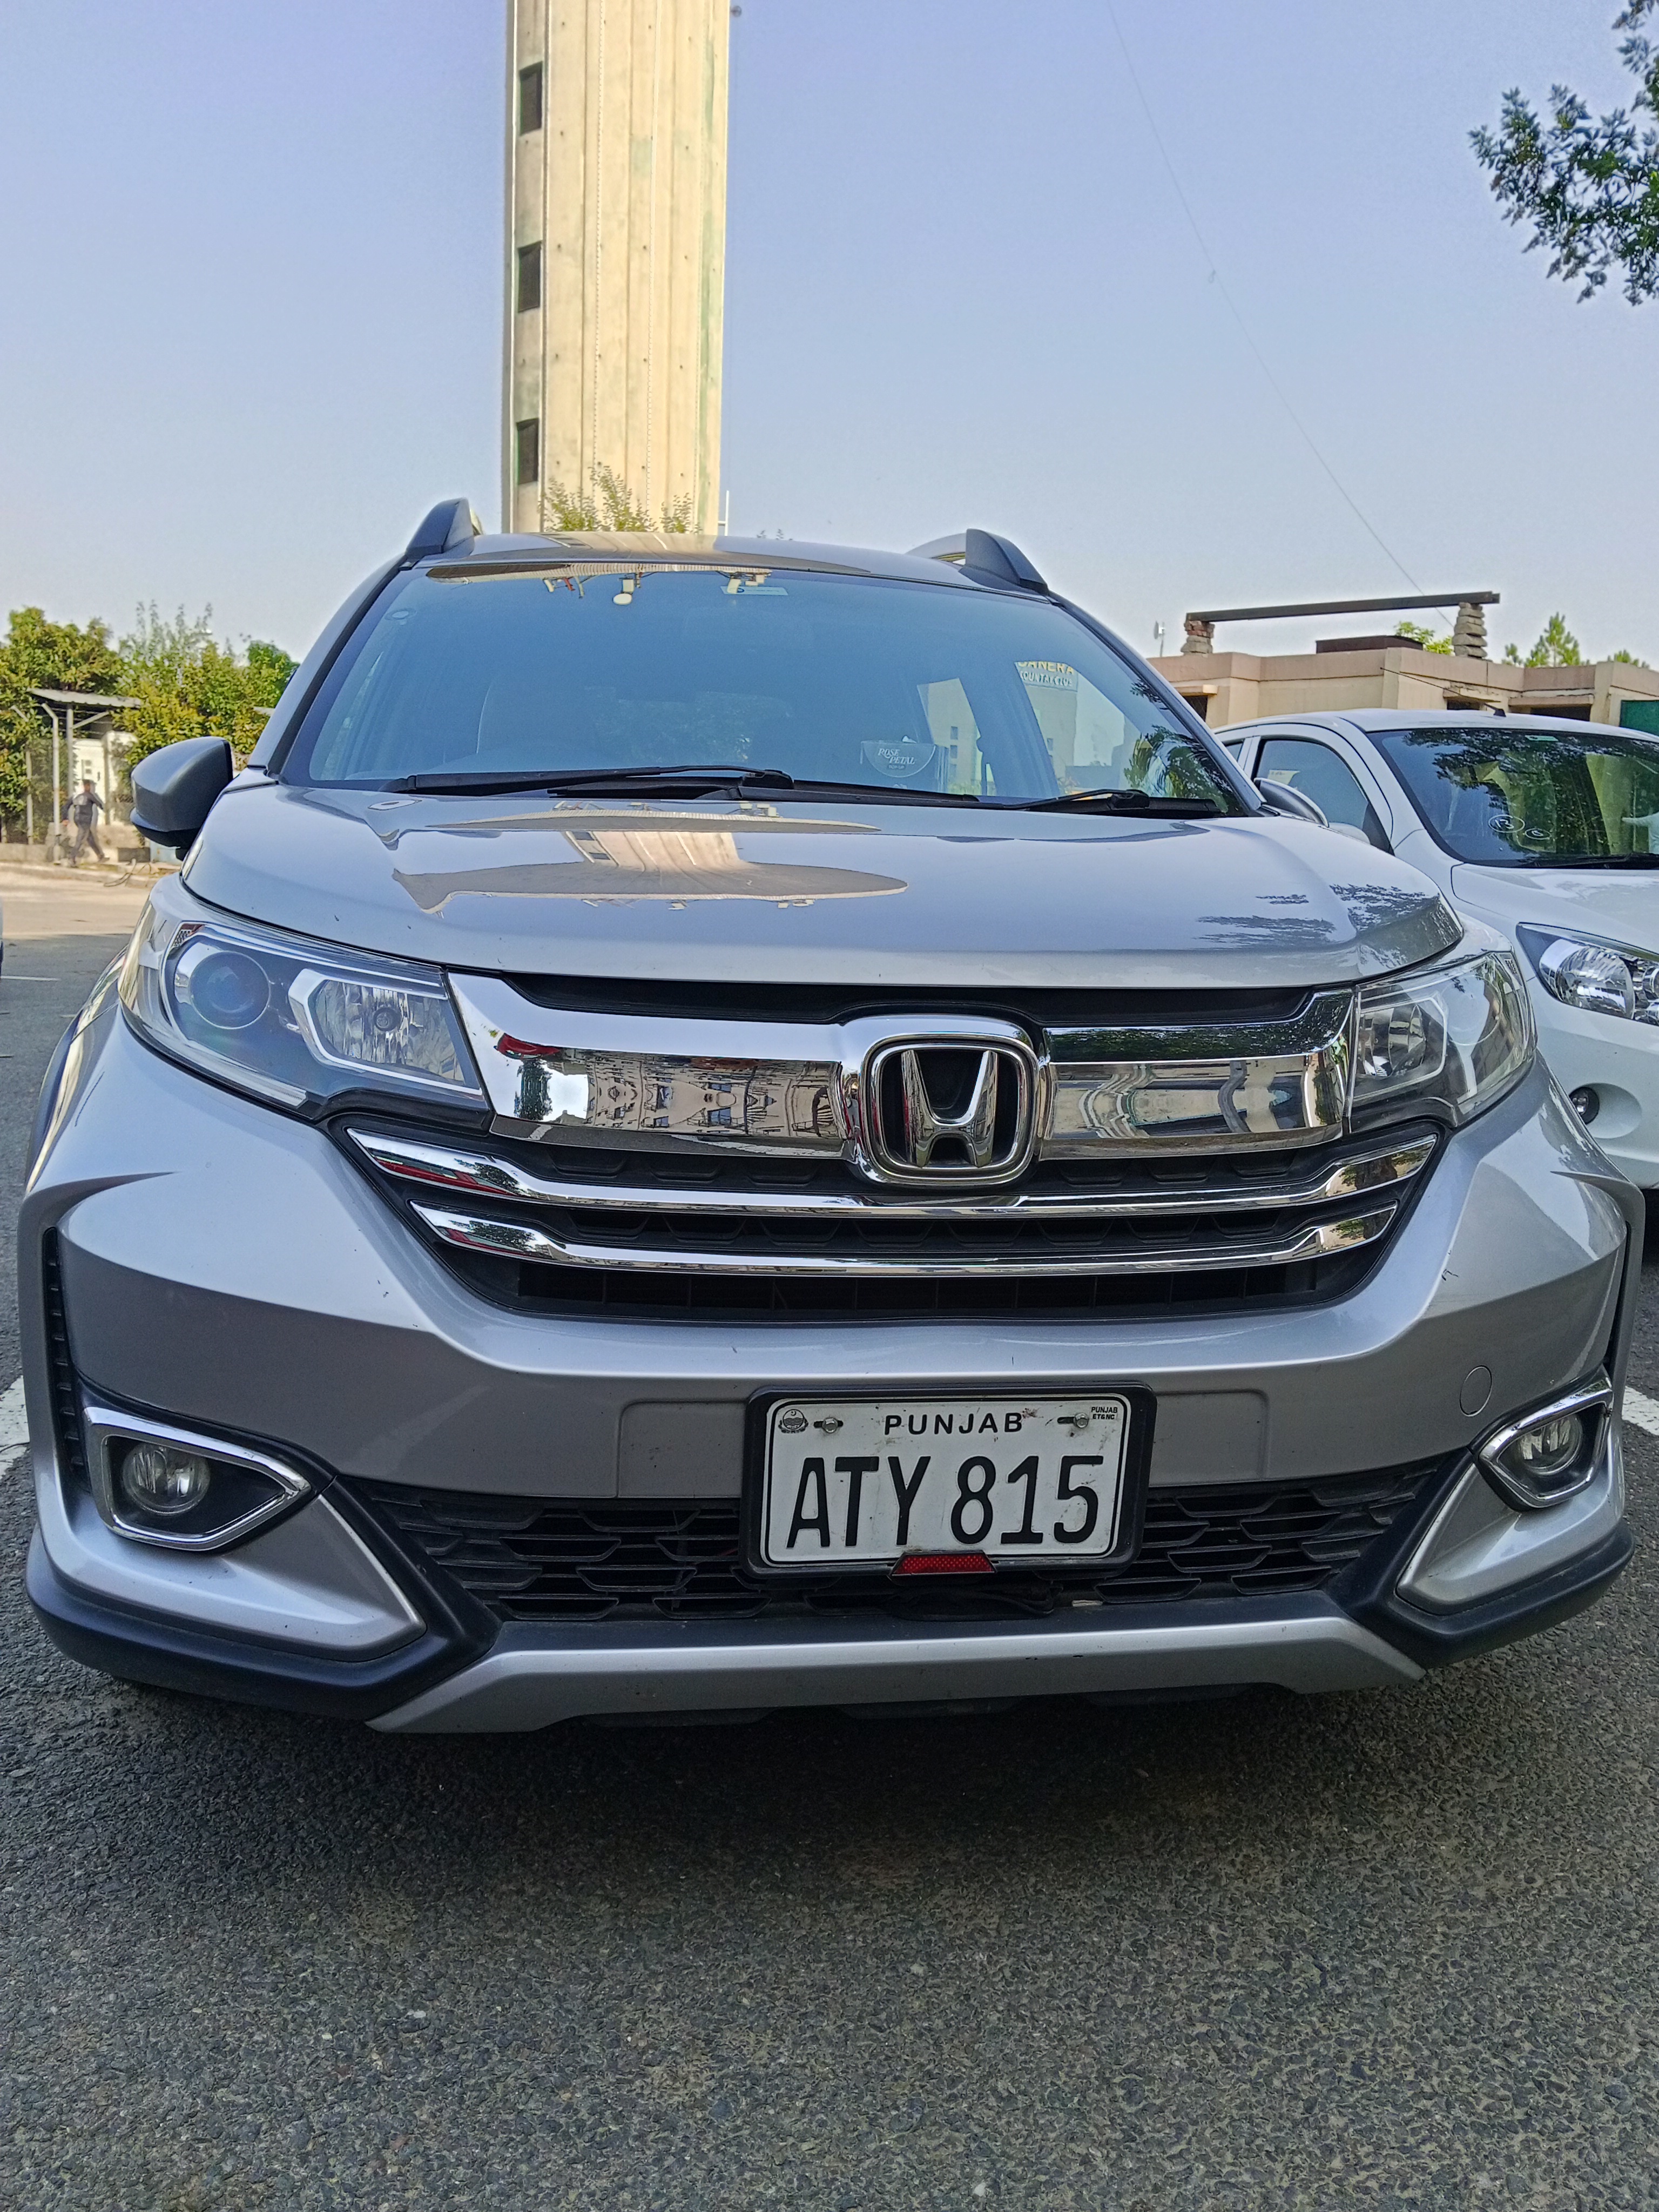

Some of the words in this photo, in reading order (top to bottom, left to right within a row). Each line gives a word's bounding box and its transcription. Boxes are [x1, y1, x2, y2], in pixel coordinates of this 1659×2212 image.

[878, 748, 900, 759] ROSE
[889, 756, 915, 765] PETAL
[884, 1412, 1023, 1435] PUNJAB
[786, 1455, 932, 1548] ATY
[950, 1455, 1104, 1545] 815
